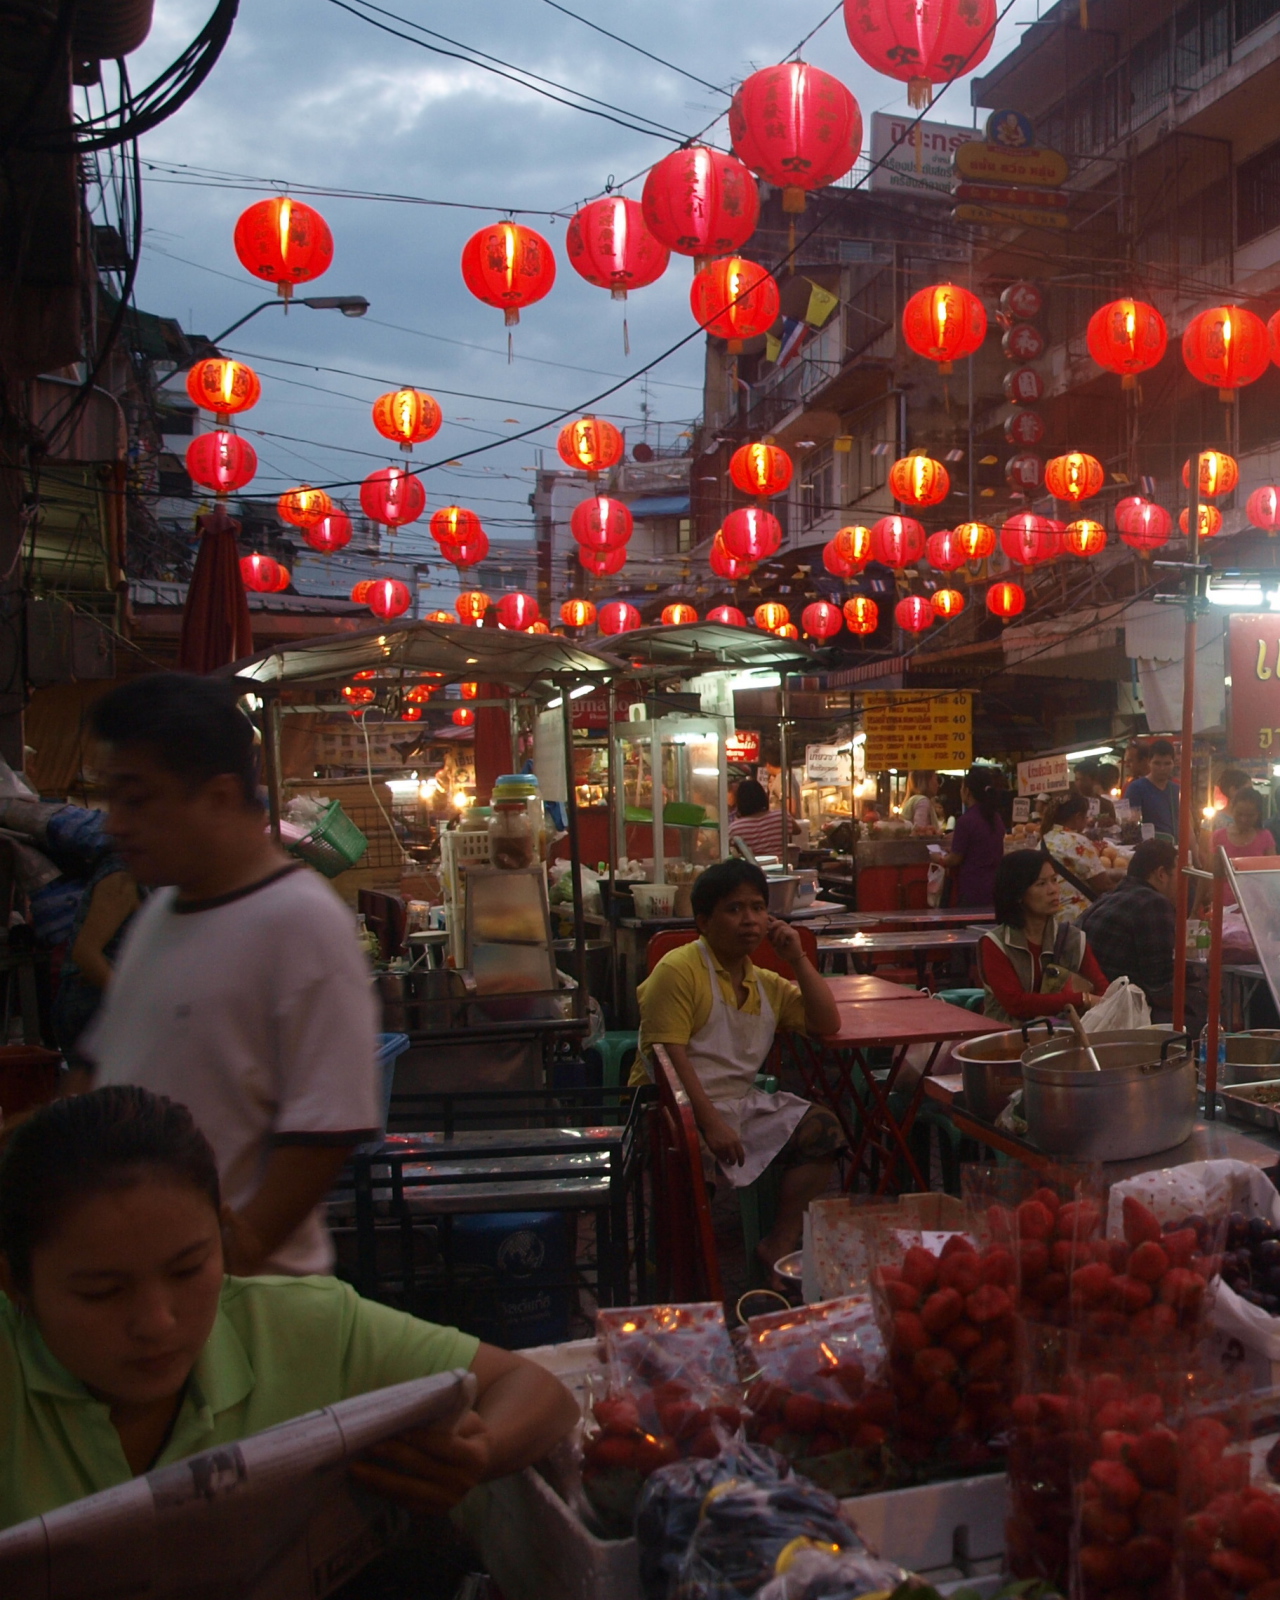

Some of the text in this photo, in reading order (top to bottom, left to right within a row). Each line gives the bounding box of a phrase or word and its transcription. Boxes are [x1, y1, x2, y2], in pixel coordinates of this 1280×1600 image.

[953, 696, 967, 705] 40
[953, 714, 966, 724] 40
[952, 732, 966, 741] 70
[952, 751, 966, 761] 70
